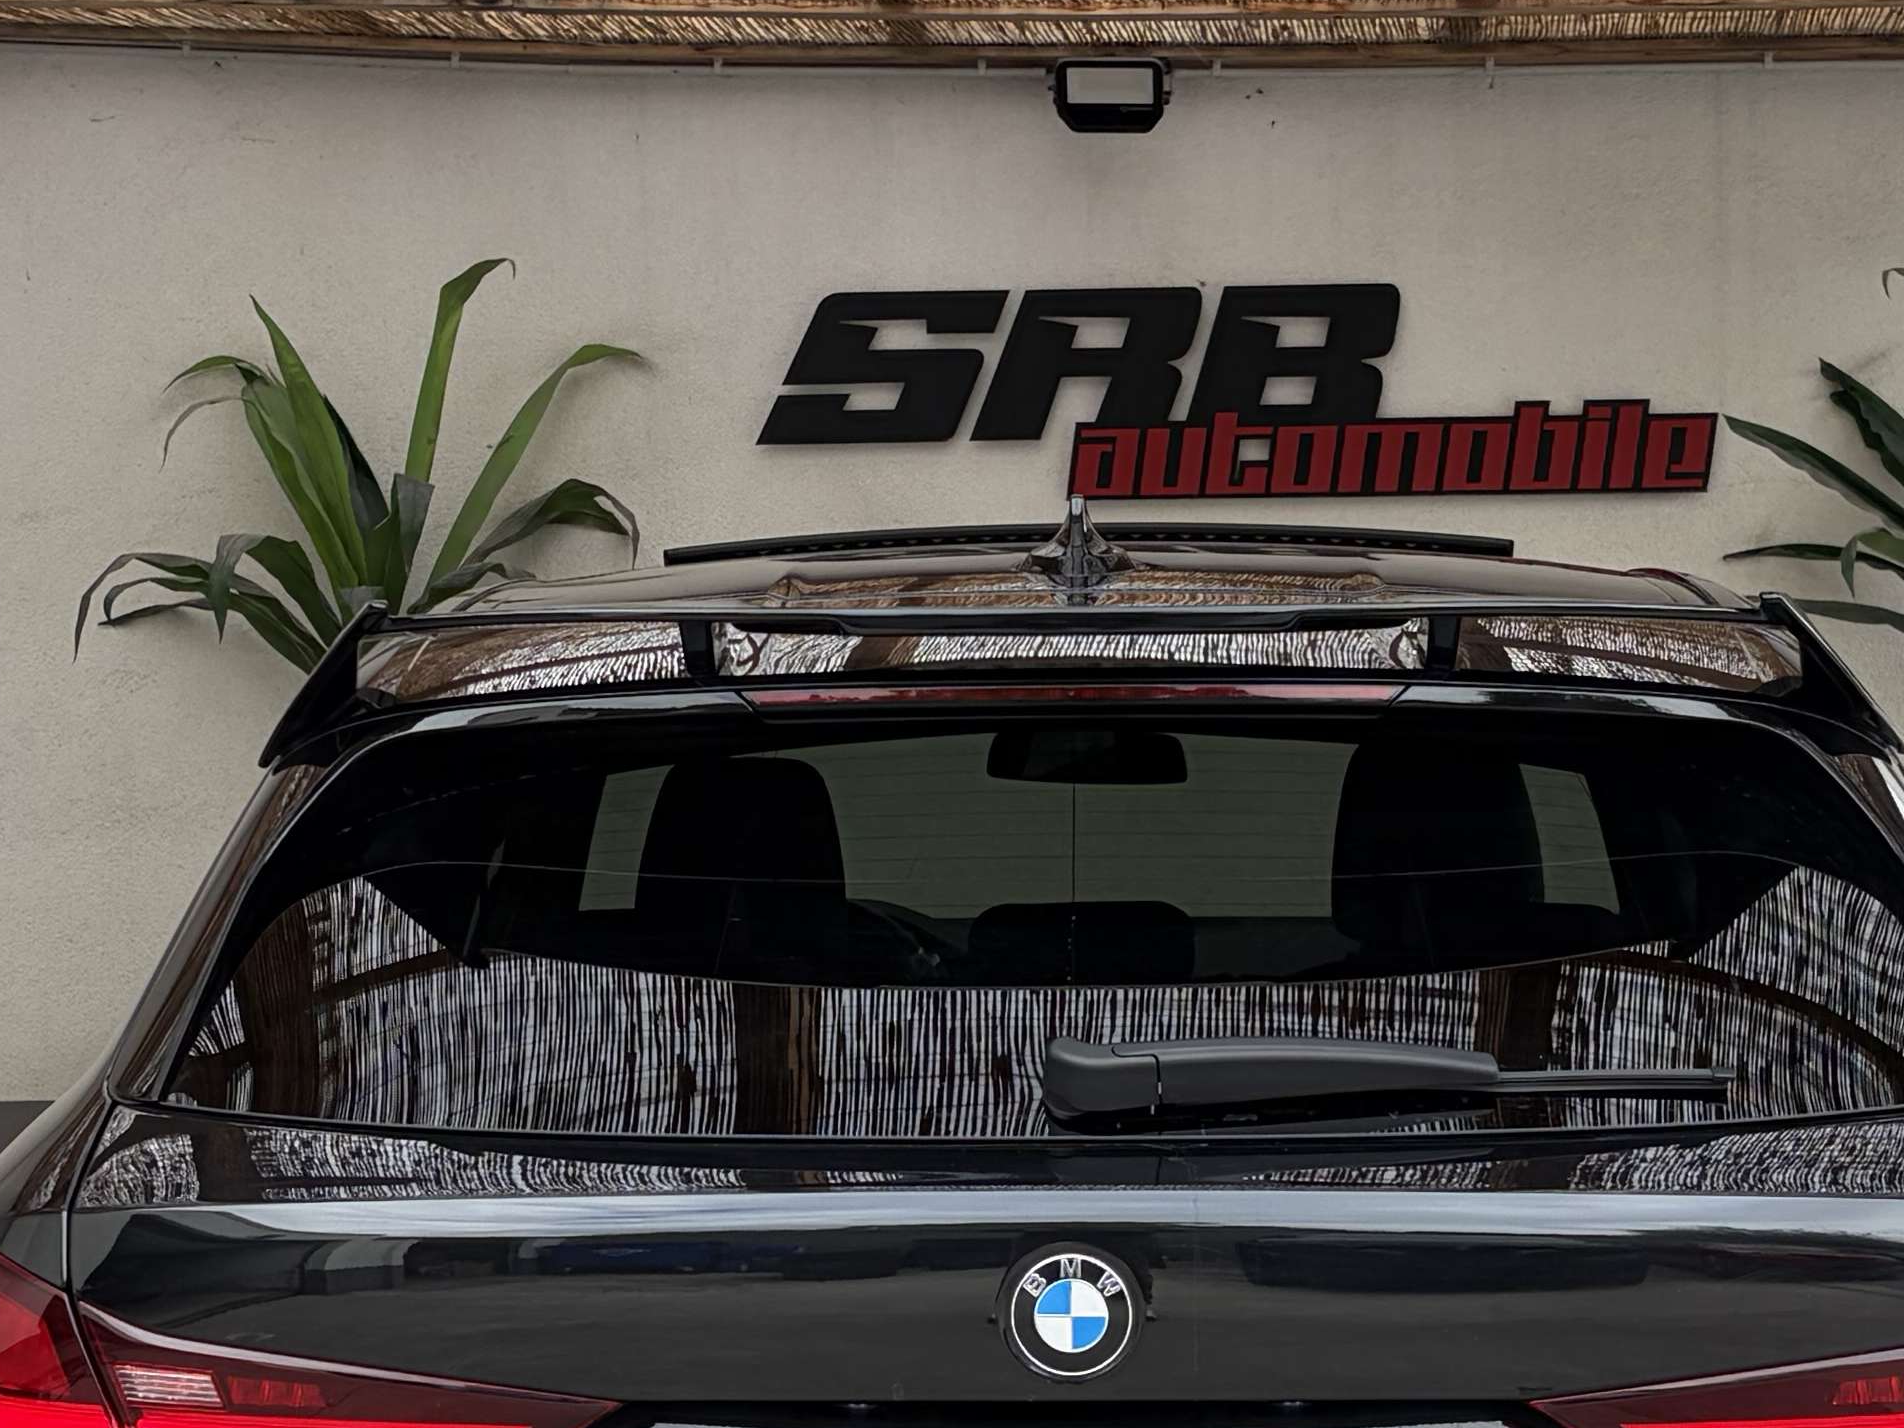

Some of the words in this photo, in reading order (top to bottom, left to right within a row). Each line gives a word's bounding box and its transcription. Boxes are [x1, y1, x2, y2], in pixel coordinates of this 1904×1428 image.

[756, 283, 1400, 446] SRB
[1070, 400, 1717, 498] automobile
[1022, 1257, 1122, 1298] BMW
